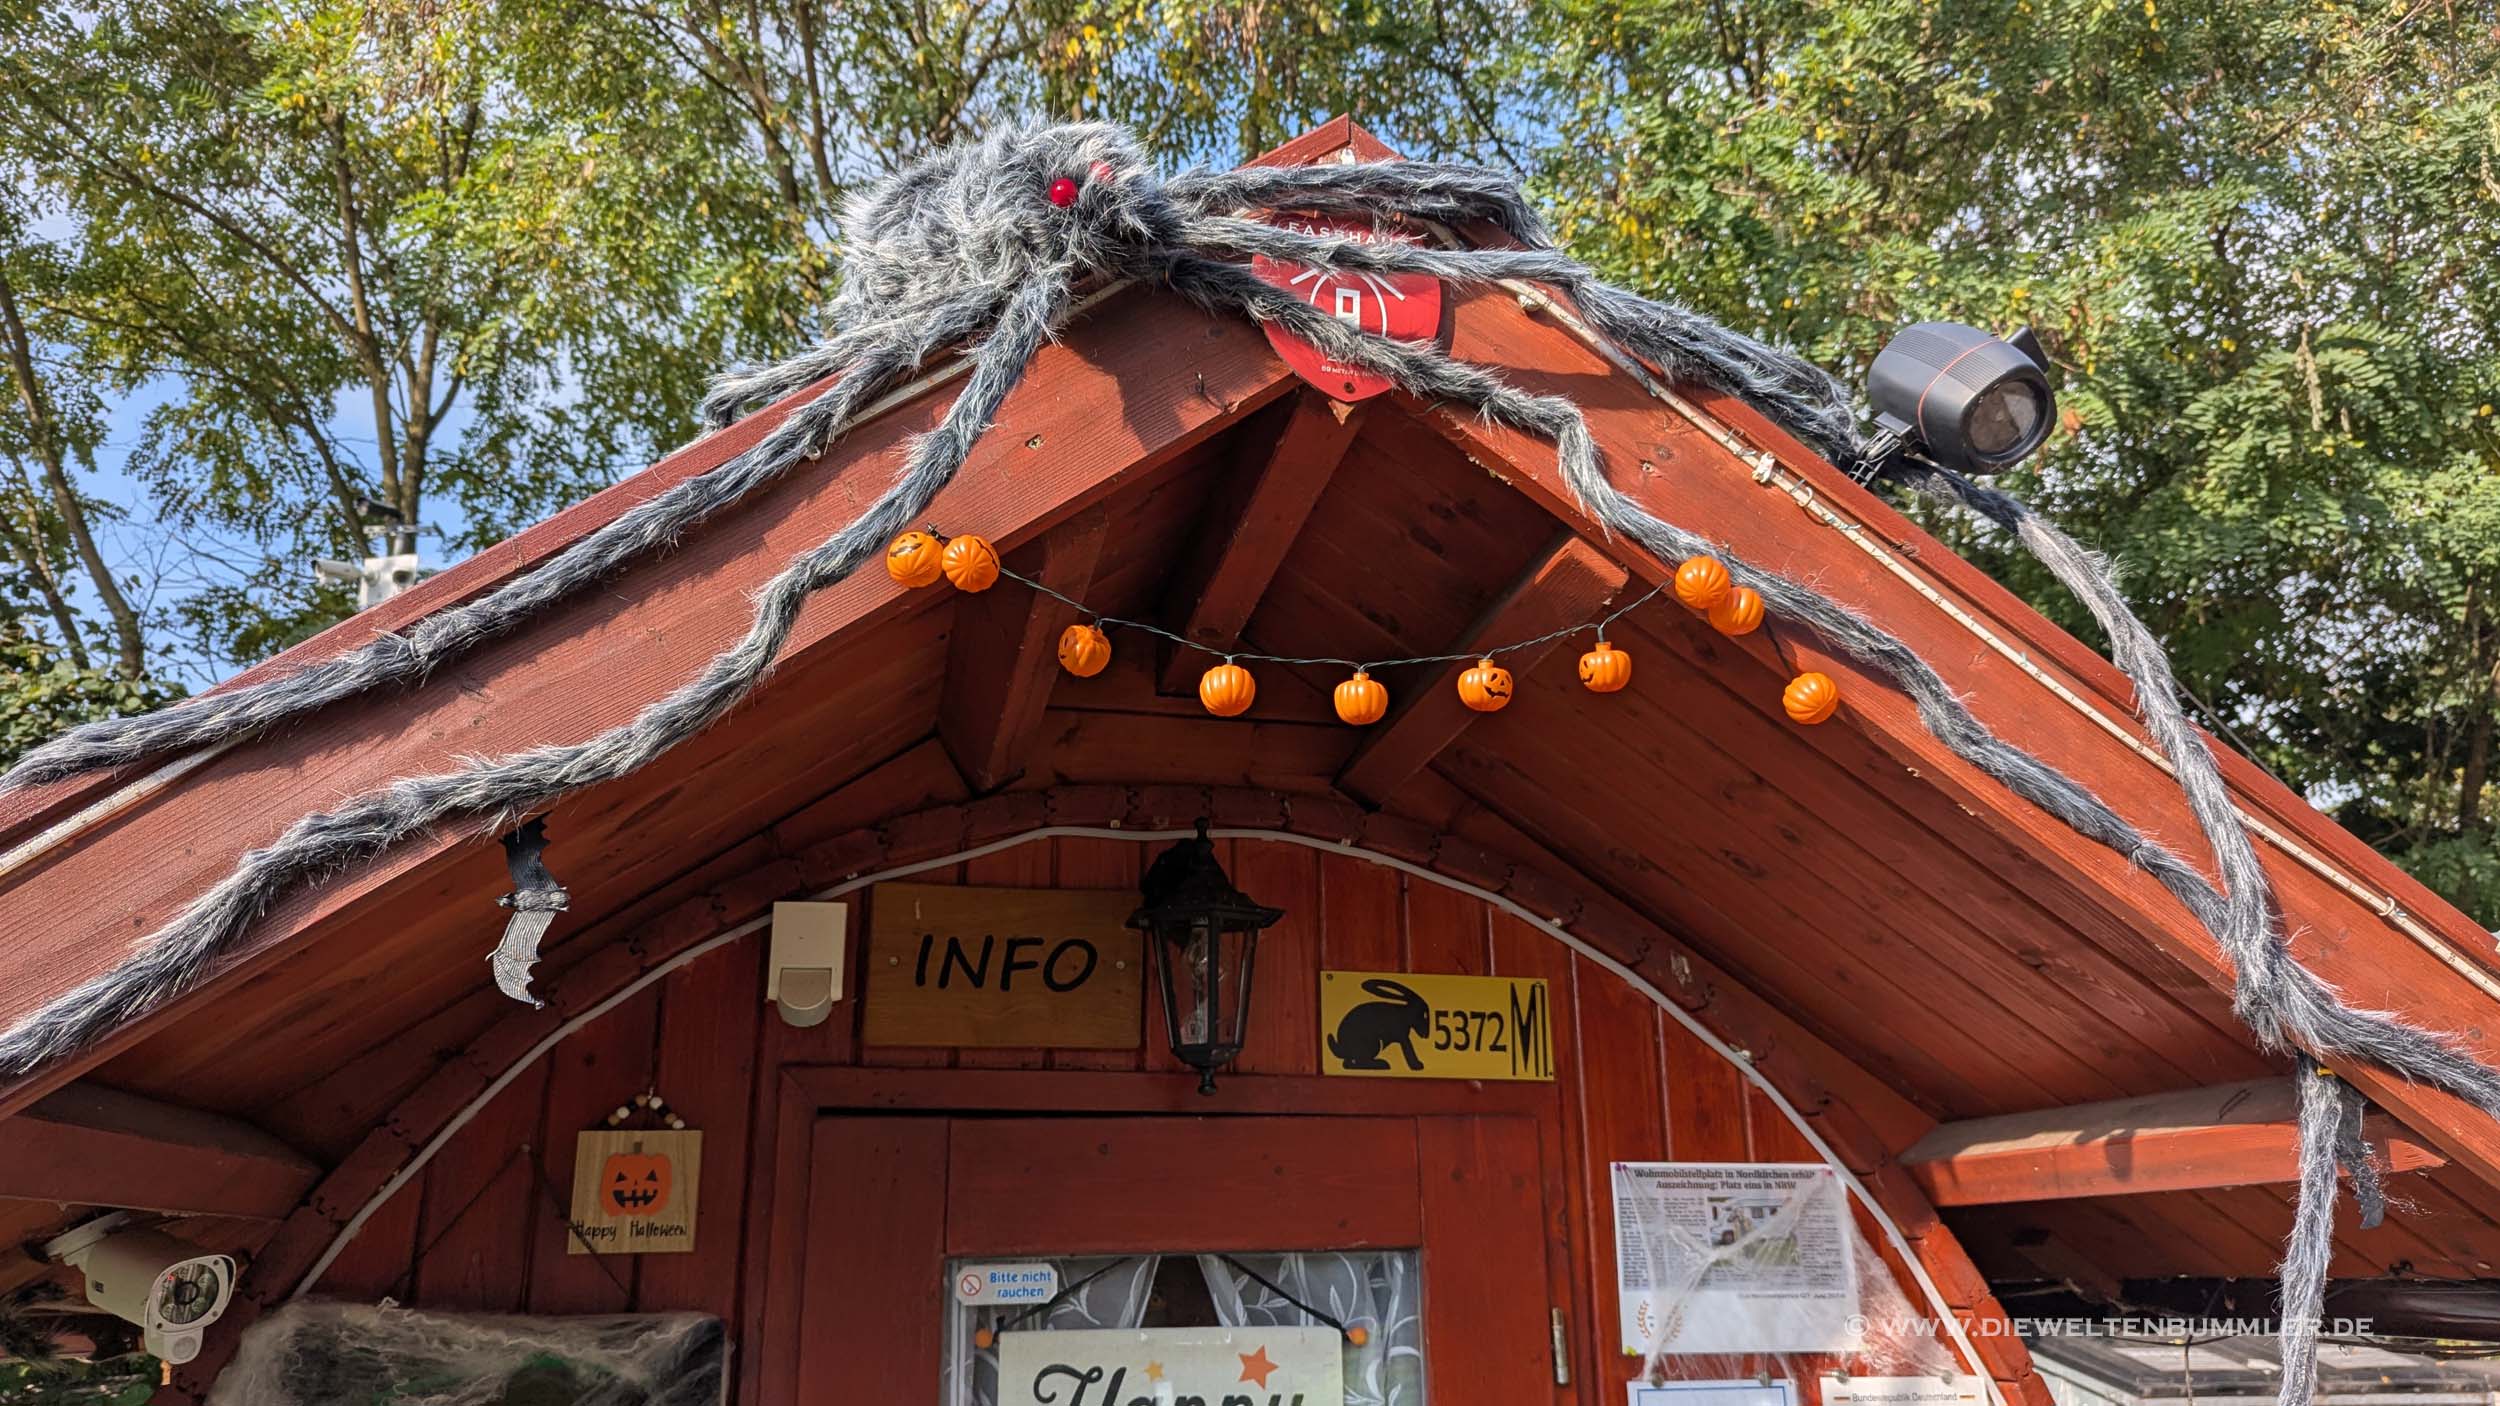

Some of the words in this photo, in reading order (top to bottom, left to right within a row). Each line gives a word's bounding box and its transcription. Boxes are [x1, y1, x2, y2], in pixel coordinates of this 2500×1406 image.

[915, 934, 1098, 992] INFO
[1434, 1010, 1507, 1052] 5372
[1725, 1168, 1734, 1178] in
[1764, 1180, 1772, 1190] in
[576, 1219, 617, 1241] Happy
[630, 1219, 689, 1238] Halloween
[989, 1271, 1018, 1284] Bitte
[1022, 1270, 1052, 1282] nicht
[997, 1287, 1044, 1298] rauchen
